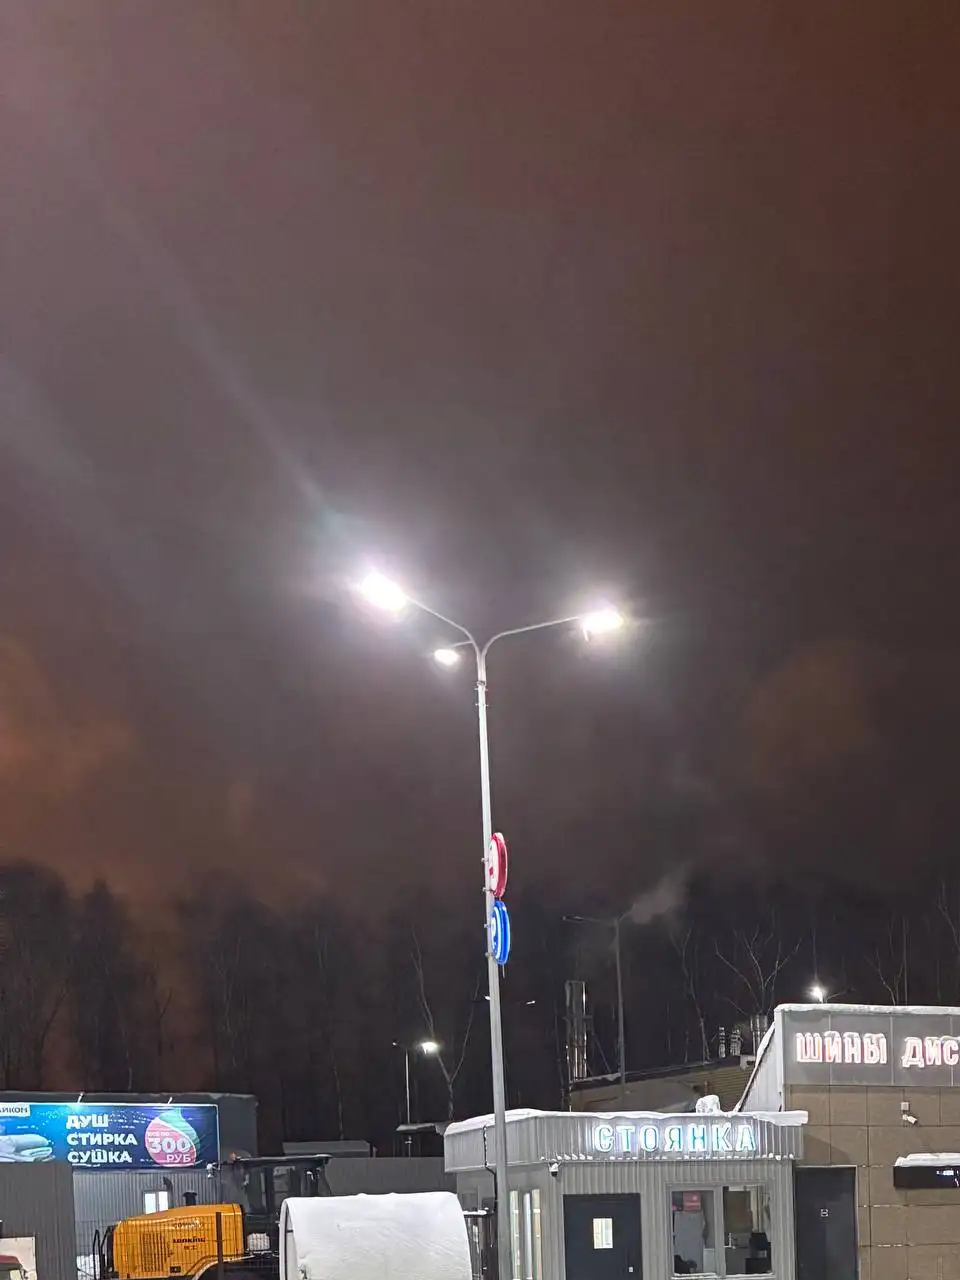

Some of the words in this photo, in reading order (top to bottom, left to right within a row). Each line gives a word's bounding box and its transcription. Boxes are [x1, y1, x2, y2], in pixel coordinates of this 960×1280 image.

[796, 1032, 887, 1064] ШИНЫ
[66, 1114, 109, 1129] ДУШ
[67, 1133, 138, 1145] СТИРКА
[593, 1123, 757, 1152] СТОЯНКА
[67, 1150, 133, 1163] СУШКА
[166, 1154, 191, 1163] РУБ
